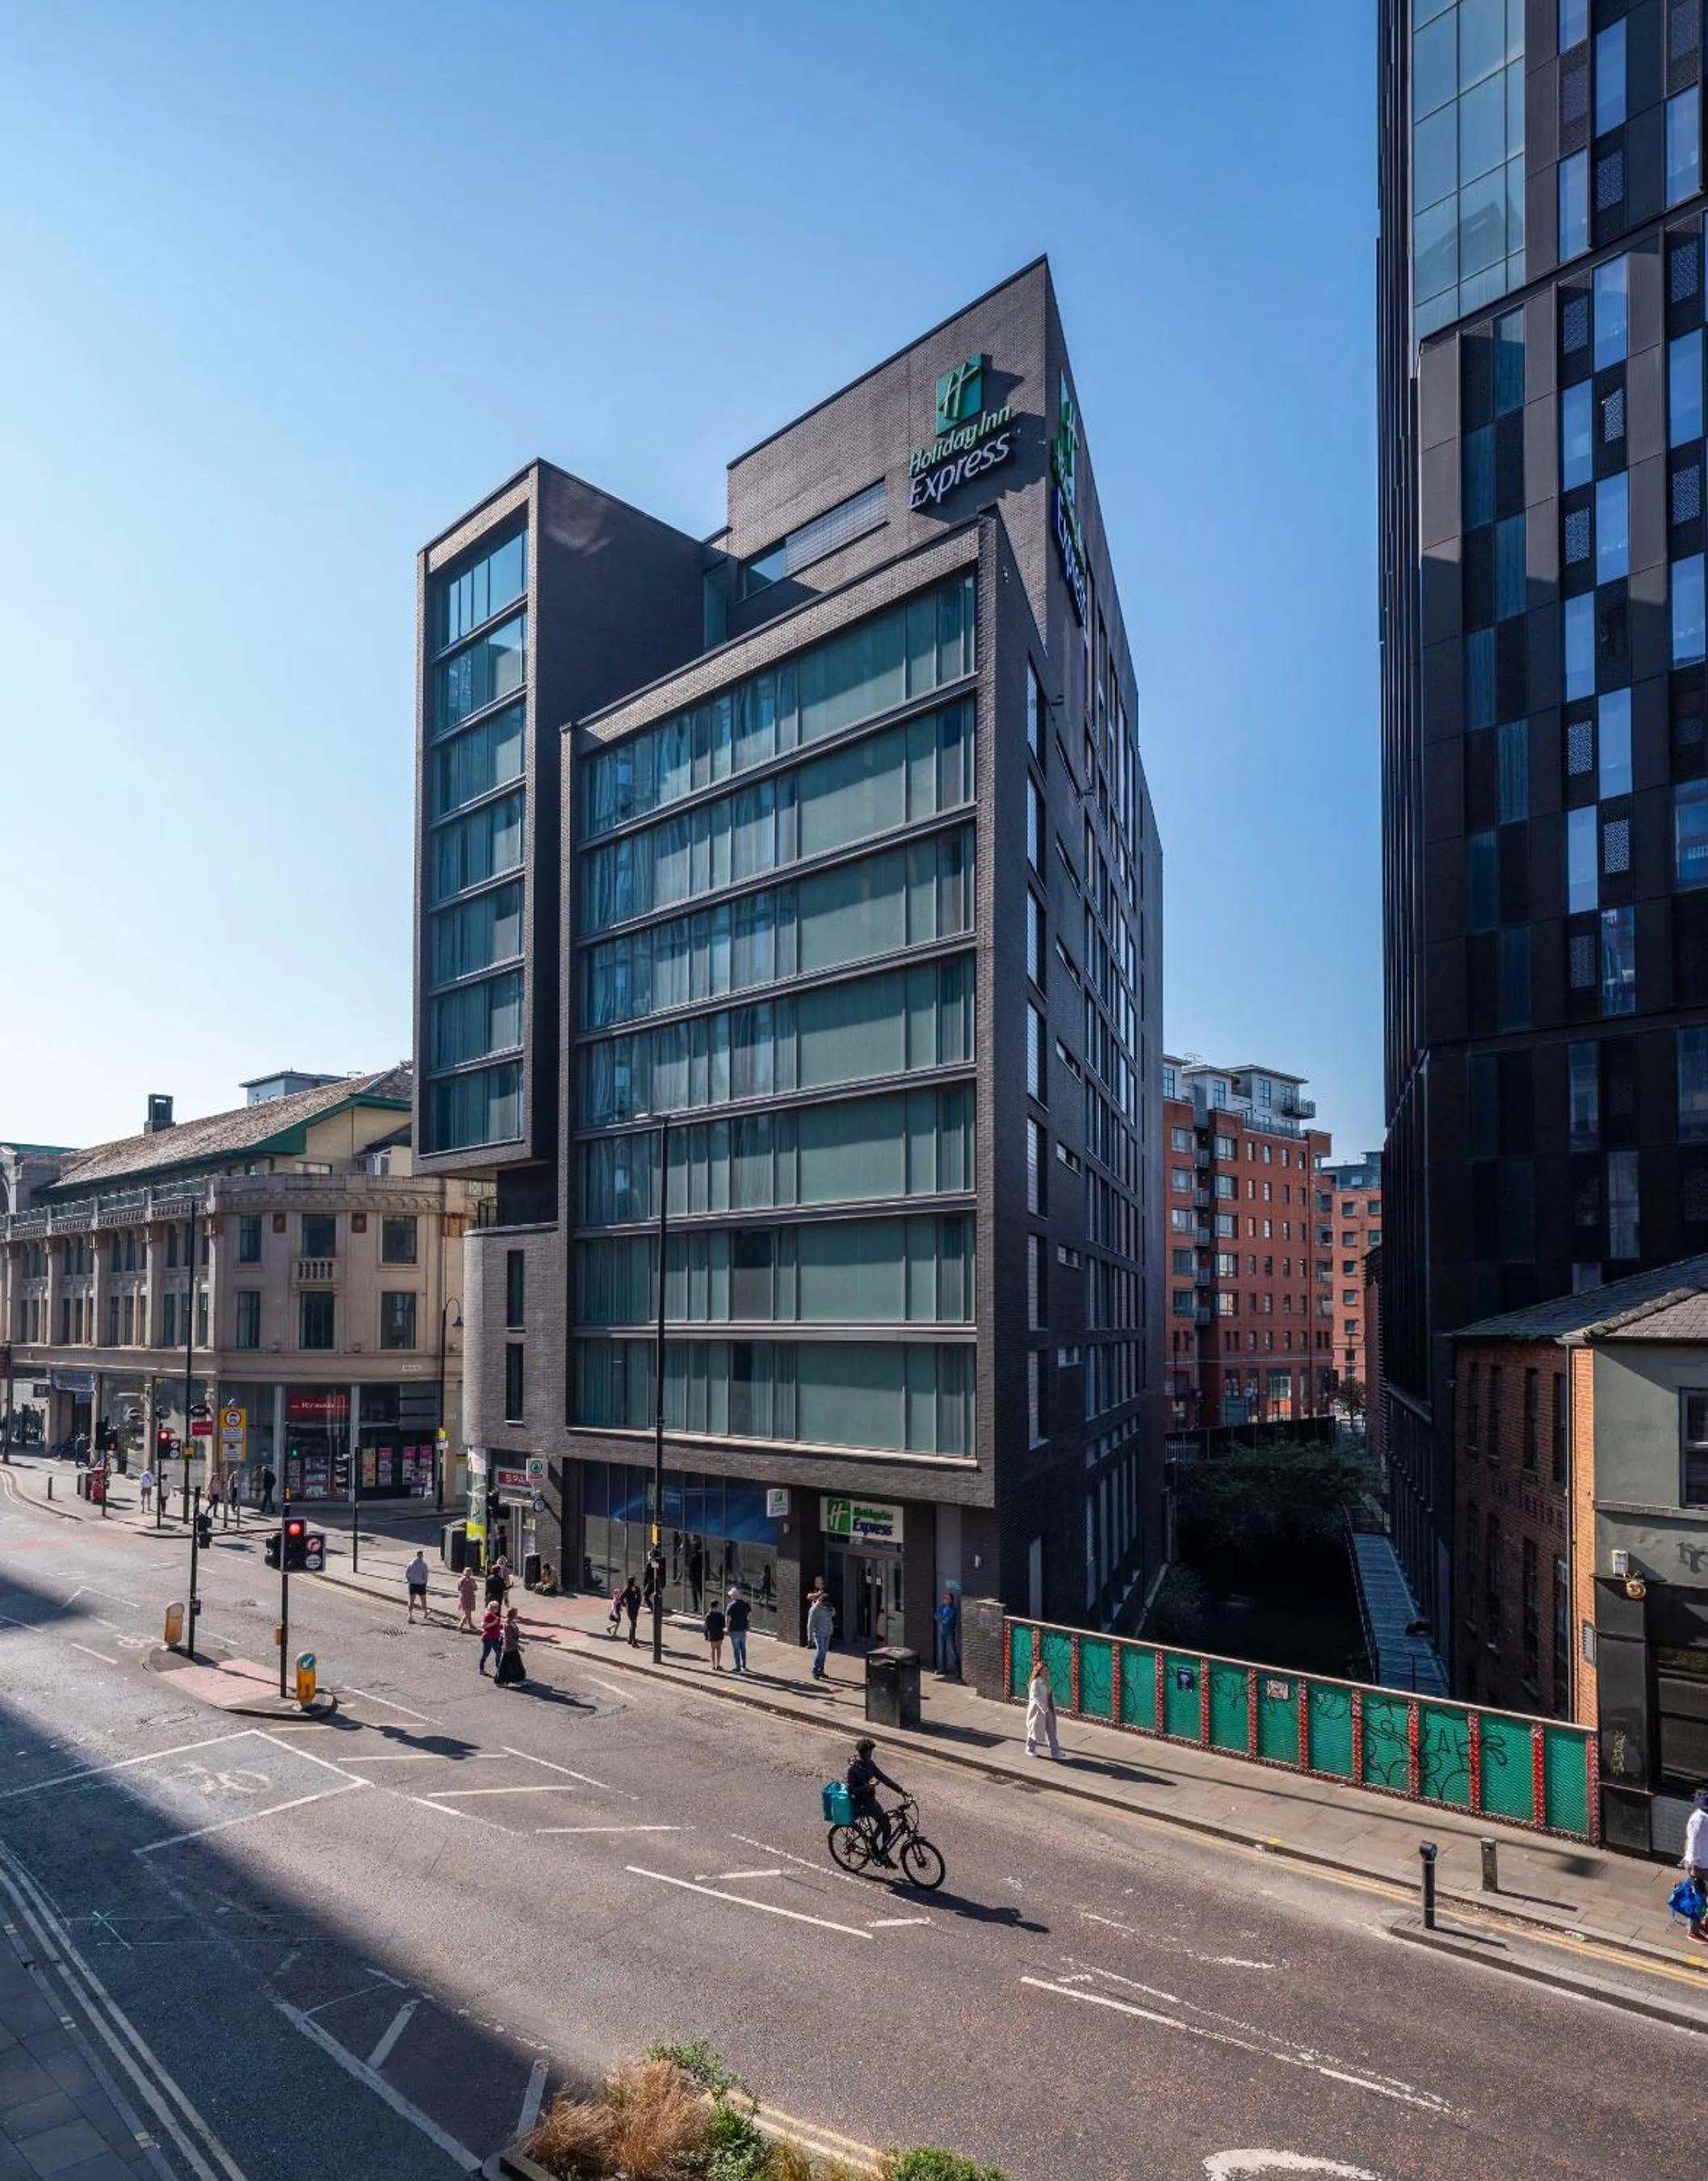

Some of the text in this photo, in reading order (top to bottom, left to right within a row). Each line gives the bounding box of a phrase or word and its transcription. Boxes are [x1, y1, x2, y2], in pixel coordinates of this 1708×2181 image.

[909, 406, 1010, 477] Holiday Inn
[909, 432, 1009, 510] Express
[505, 1473, 530, 1485] SPA
